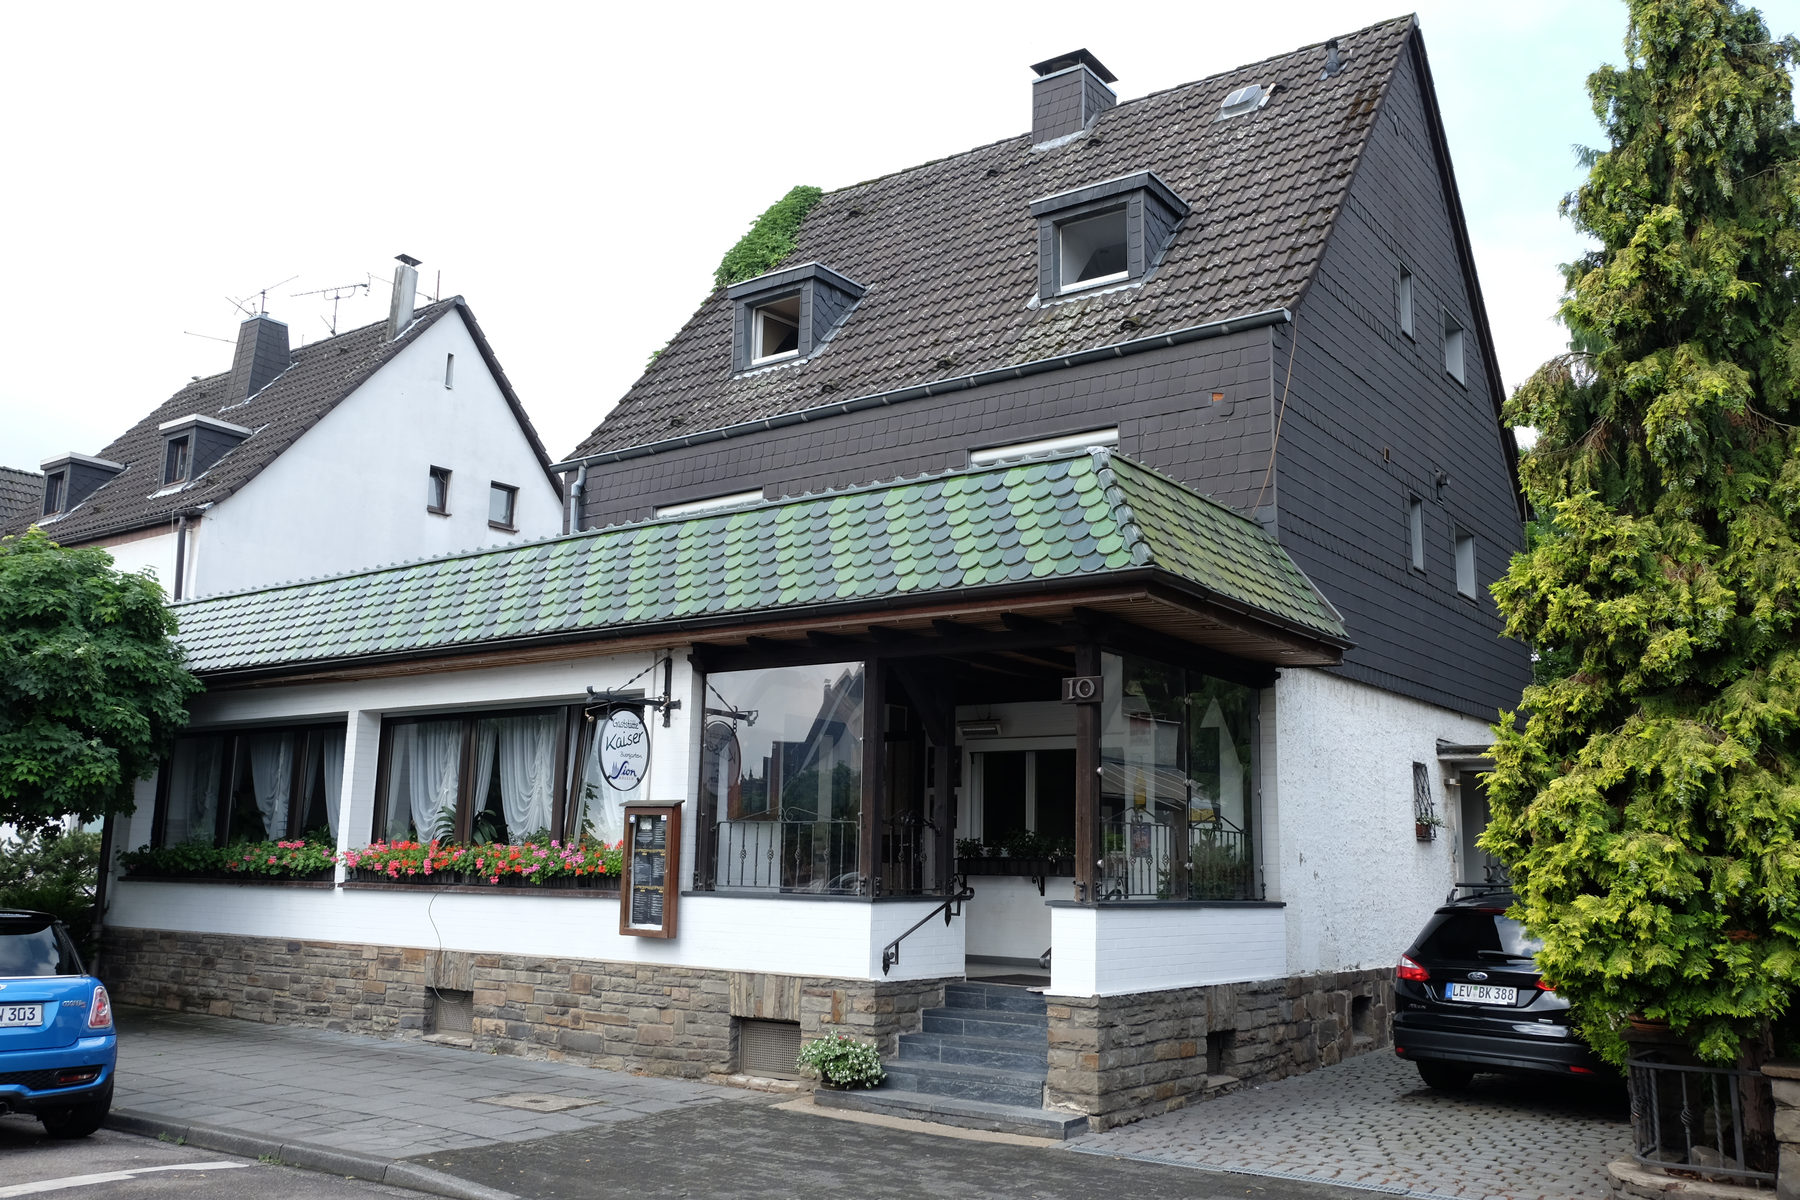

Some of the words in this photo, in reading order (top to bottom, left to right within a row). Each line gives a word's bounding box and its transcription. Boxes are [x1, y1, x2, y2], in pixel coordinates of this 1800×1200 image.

[1067, 678, 1096, 700] 10
[606, 731, 644, 751] Kaiser
[610, 760, 637, 779] Sion
[1452, 985, 1473, 997] LEV
[1478, 987, 1495, 999] BK
[1495, 988, 1514, 1000] 388
[8, 1007, 36, 1021] 303
